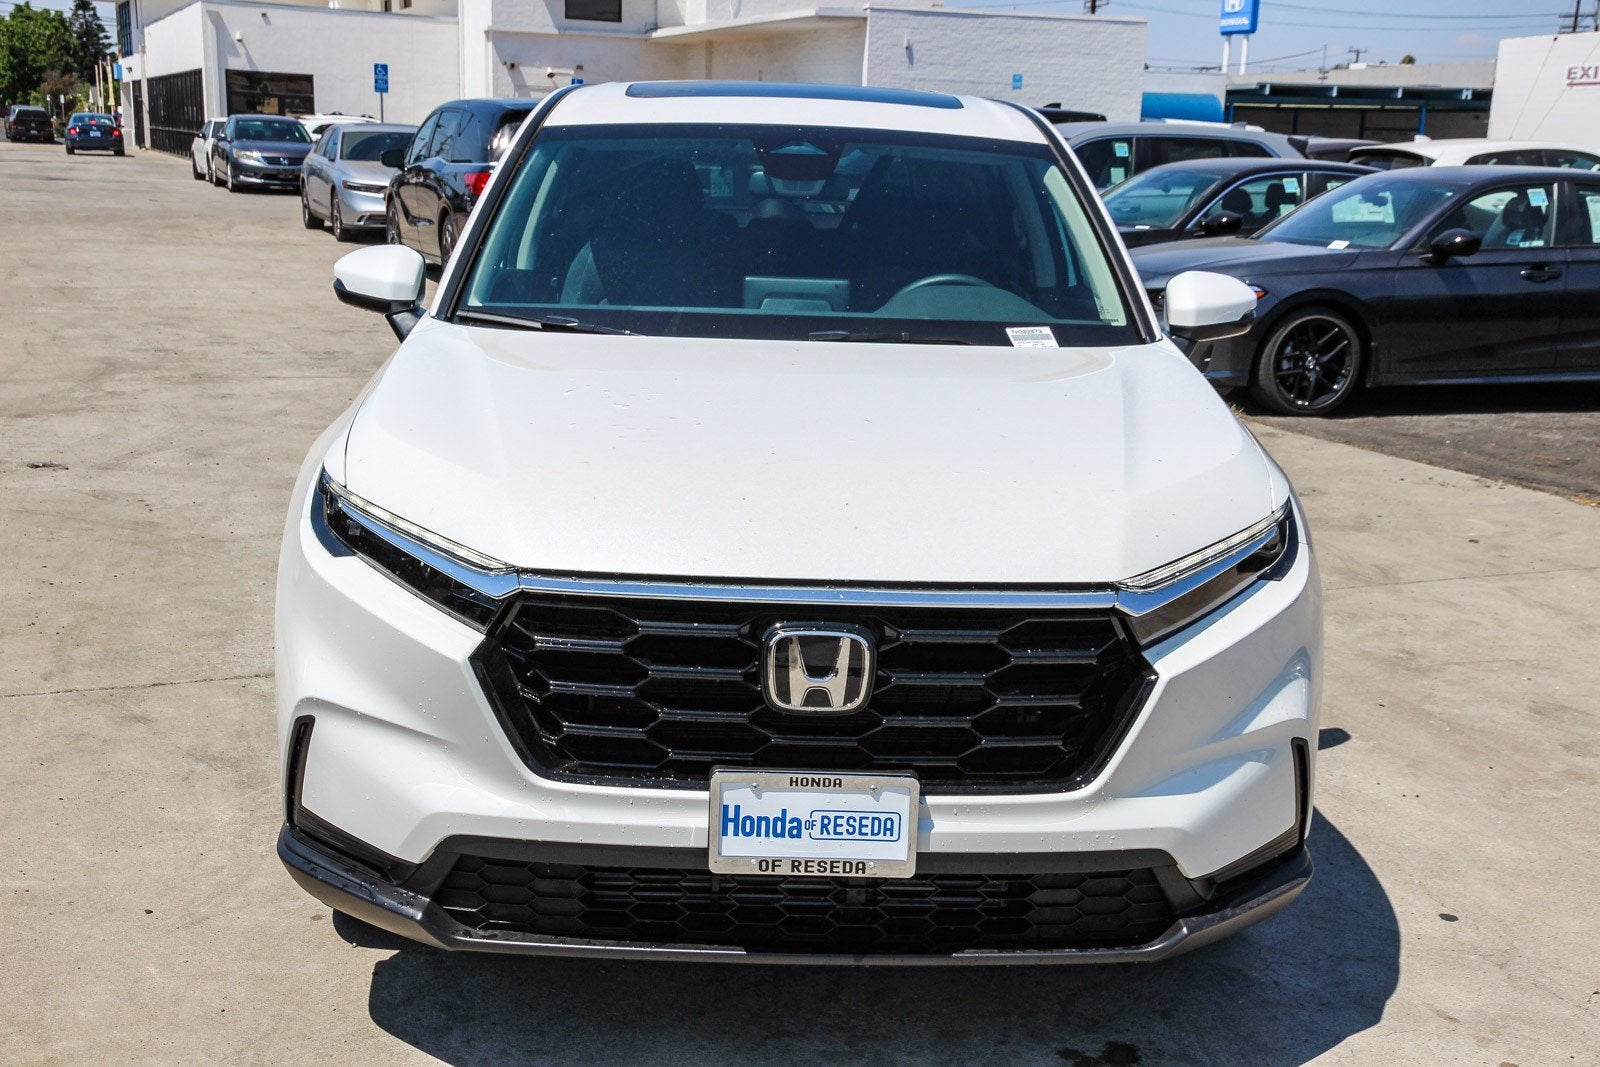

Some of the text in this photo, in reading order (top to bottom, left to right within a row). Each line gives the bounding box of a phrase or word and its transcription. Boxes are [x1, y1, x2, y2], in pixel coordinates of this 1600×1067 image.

[789, 776, 843, 788] HONDA
[721, 804, 895, 839] Honda OF RESEDA
[758, 859, 867, 875] OF RESEDA
